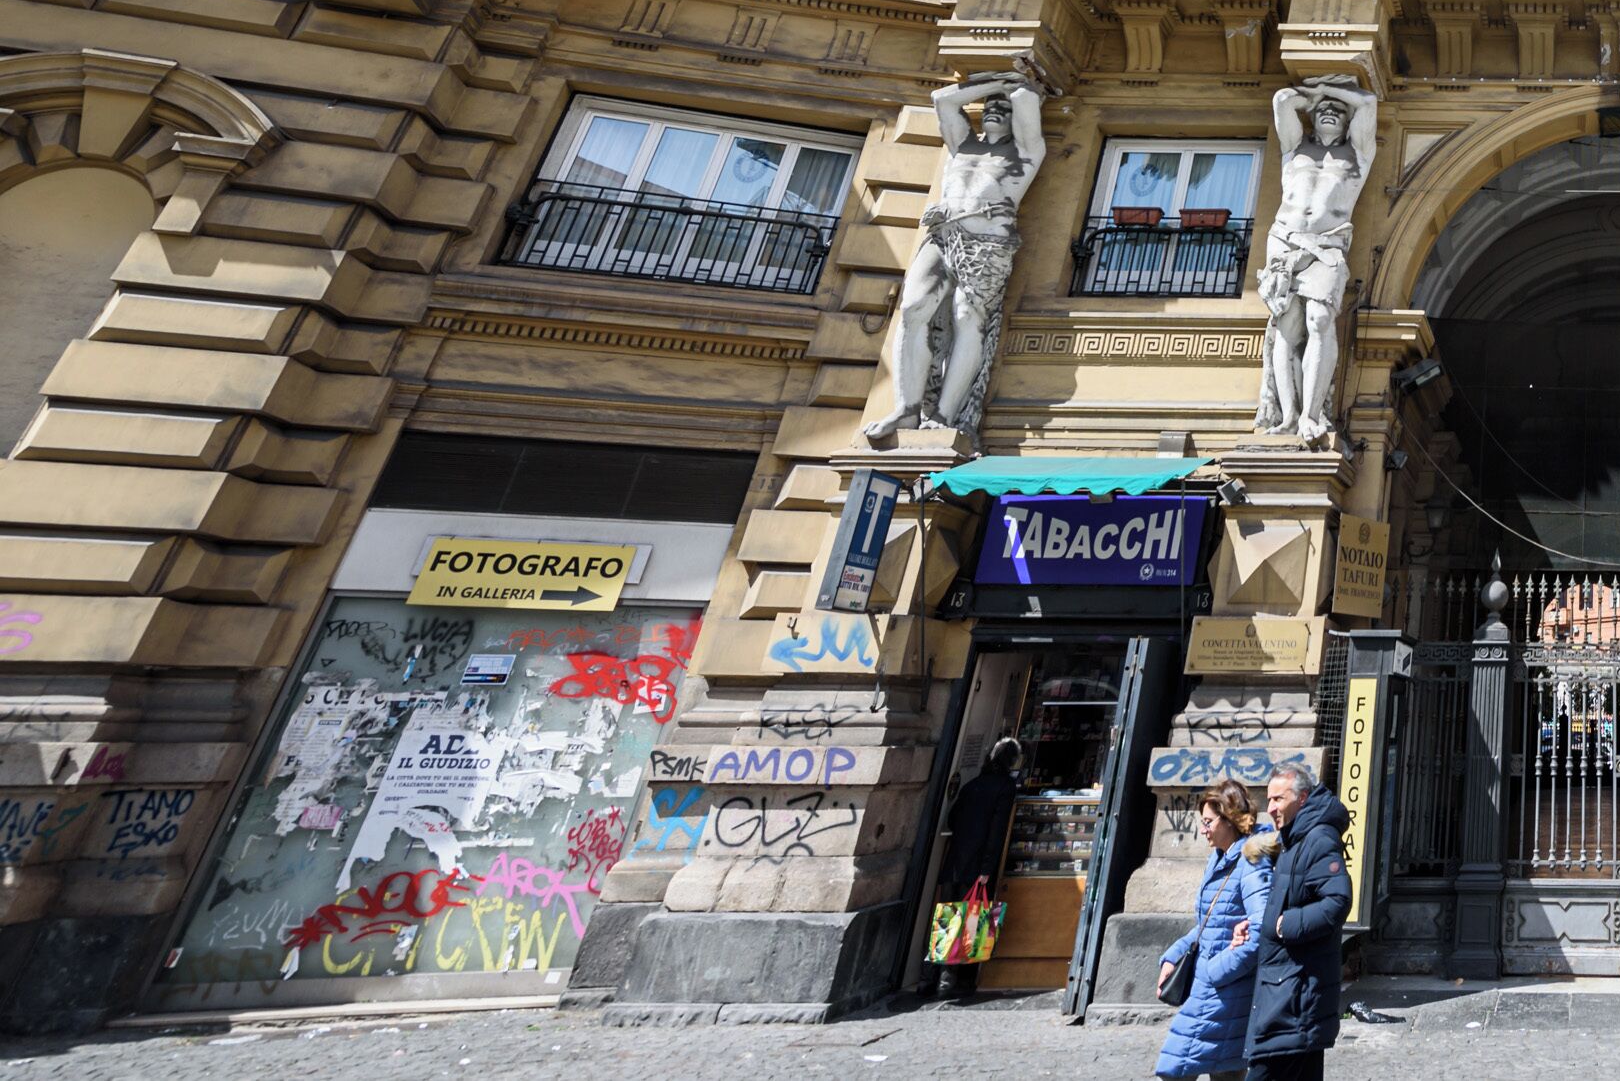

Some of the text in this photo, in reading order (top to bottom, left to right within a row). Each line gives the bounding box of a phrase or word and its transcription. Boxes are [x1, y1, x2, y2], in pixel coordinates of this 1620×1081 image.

[1003, 507, 1186, 560] TABACCHI
[429, 550, 624, 579] FOTOGRAFO
[1341, 546, 1383, 569] NOTAIO
[1342, 567, 1378, 587] TAFURI
[436, 586, 535, 600] IN GALLERIA
[1202, 639, 1297, 649] CONCETTA VALENTINO
[397, 757, 491, 770] IL GIUDIZIO
